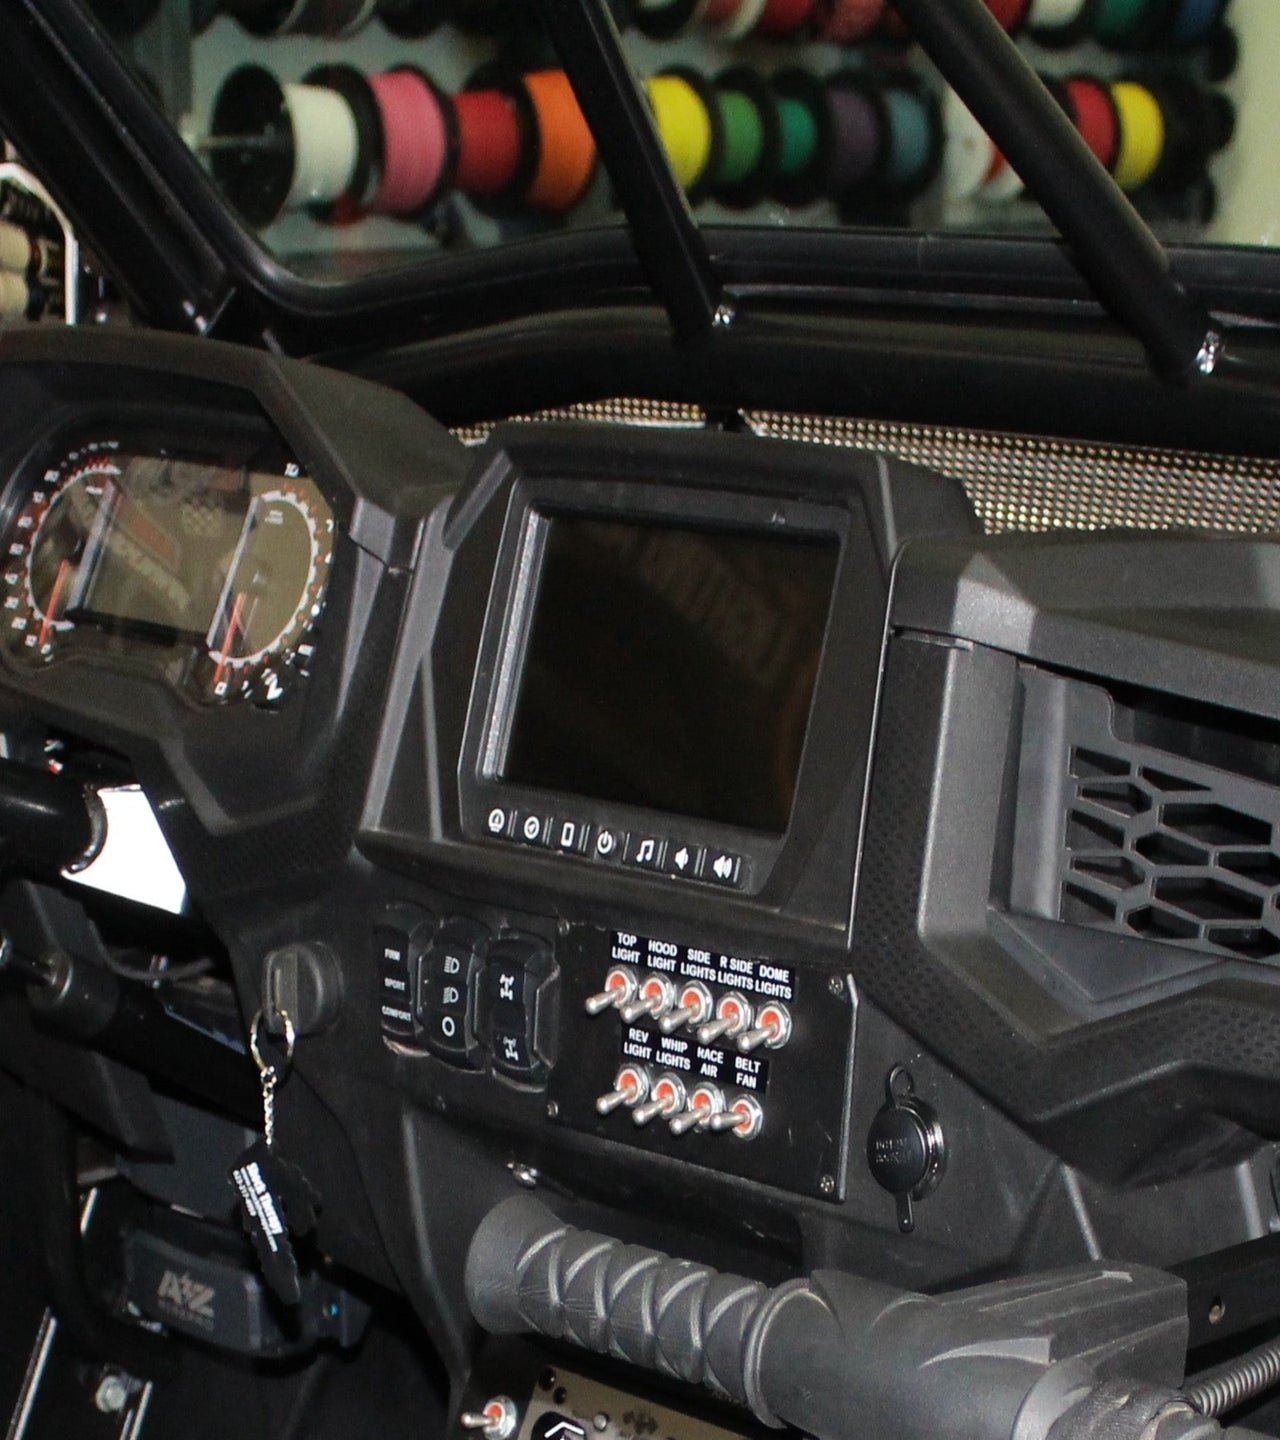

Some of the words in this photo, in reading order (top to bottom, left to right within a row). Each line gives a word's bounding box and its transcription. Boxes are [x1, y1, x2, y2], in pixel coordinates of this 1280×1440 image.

[617, 932, 637, 948] TOP
[648, 940, 678, 957] HOOD
[384, 948, 400, 961] FIRM
[612, 947, 641, 964] LIGHT
[687, 949, 711, 965] SIDE
[647, 955, 677, 972] LIGHT
[680, 962, 717, 982] LIGHTS
[720, 956, 728, 968] R
[730, 959, 754, 975] SIDE
[717, 971, 754, 991] LIGHTS
[759, 965, 790, 984] DOME
[384, 977, 406, 991] SPORT
[755, 979, 793, 1000] LIGHTS
[381, 1005, 412, 1022] COMFORT
[628, 1027, 650, 1043] REV
[623, 1042, 652, 1060] LIGHT
[661, 1036, 689, 1054] WHIP
[655, 1050, 692, 1071] LIGHTS
[696, 1046, 724, 1065] RACE
[700, 1063, 718, 1078] AIR
[735, 1056, 761, 1075] BELT
[736, 1073, 757, 1089] FAN
